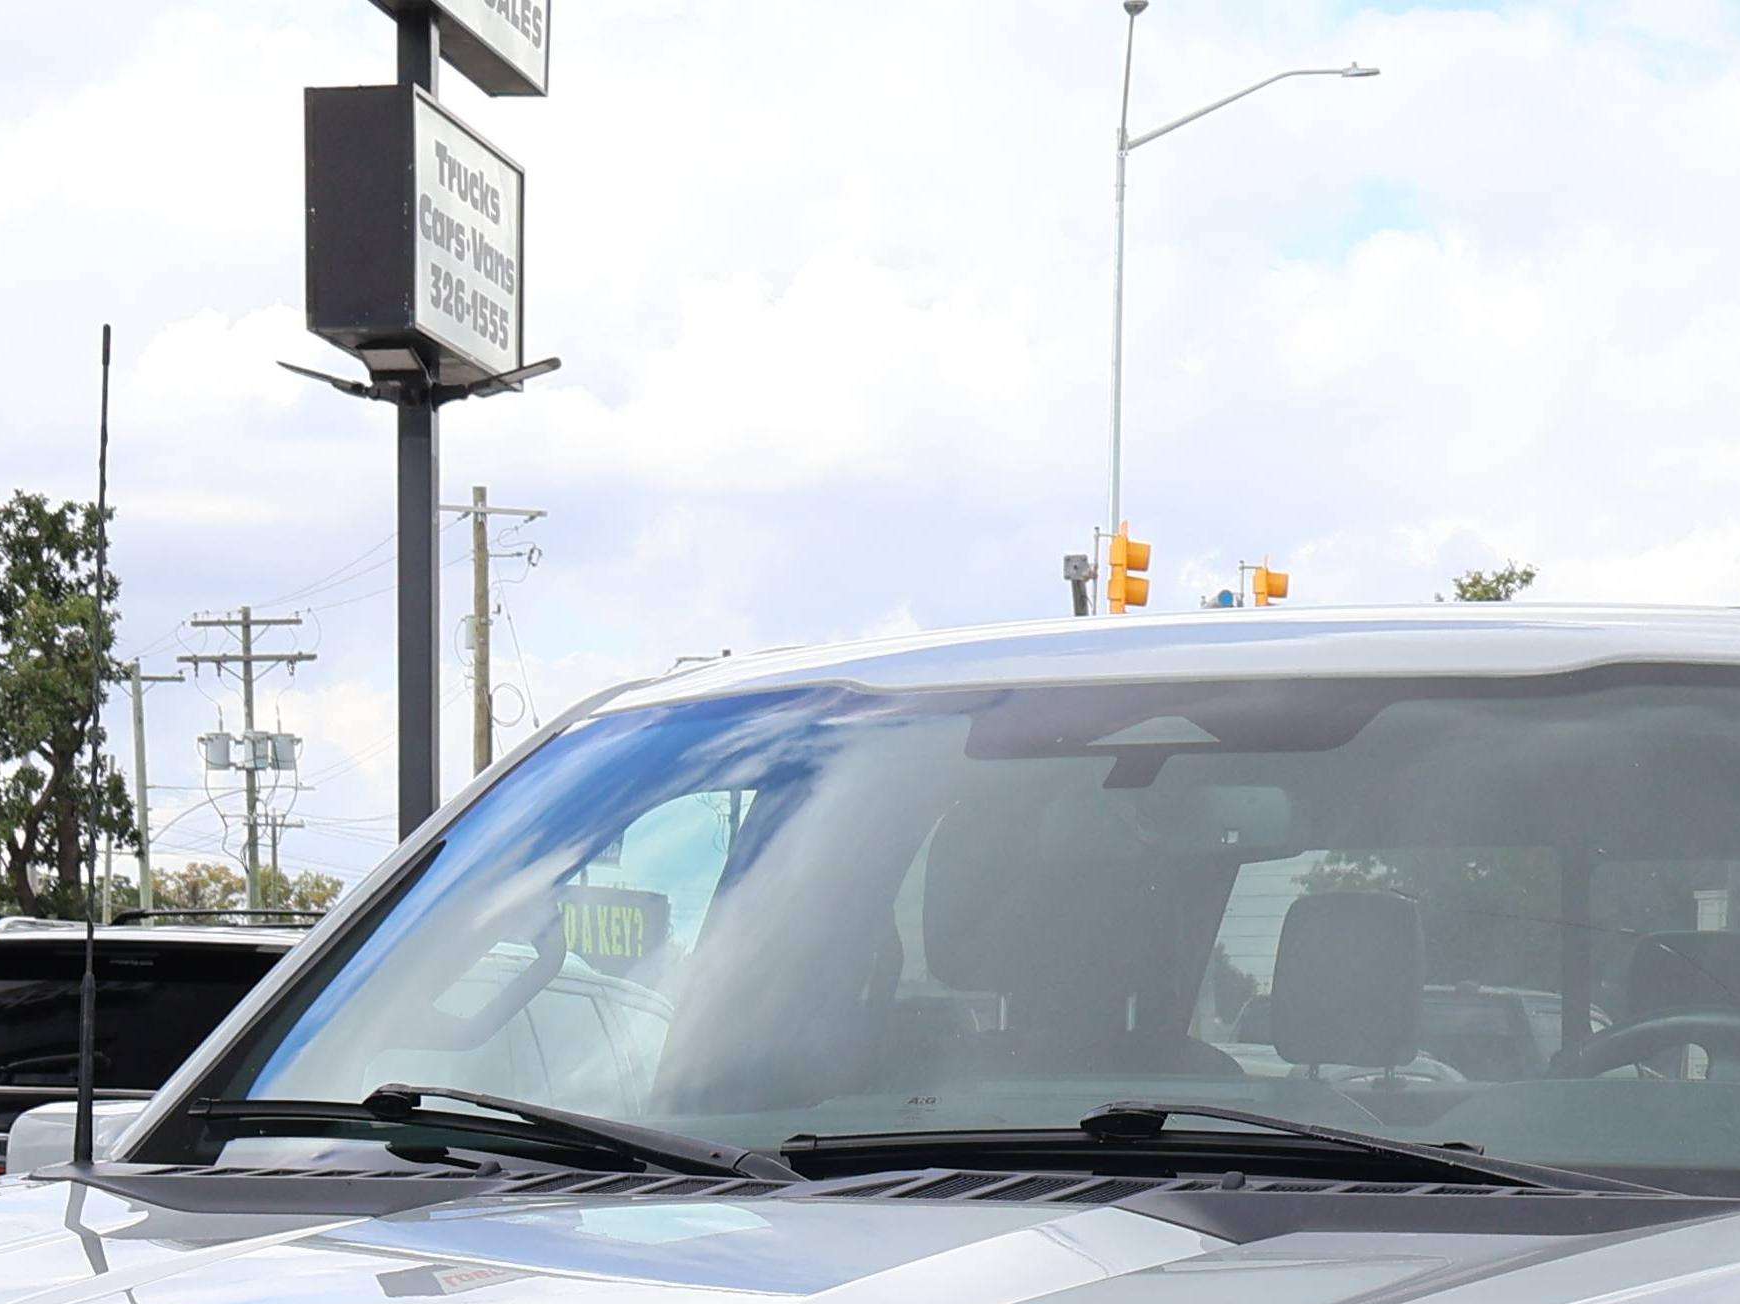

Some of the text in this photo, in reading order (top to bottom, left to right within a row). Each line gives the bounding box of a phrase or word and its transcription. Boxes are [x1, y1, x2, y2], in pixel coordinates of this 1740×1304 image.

[435, 139, 501, 225] Trucks
[430, 262, 509, 351] 326-1555
[596, 905, 644, 957] KEY?
